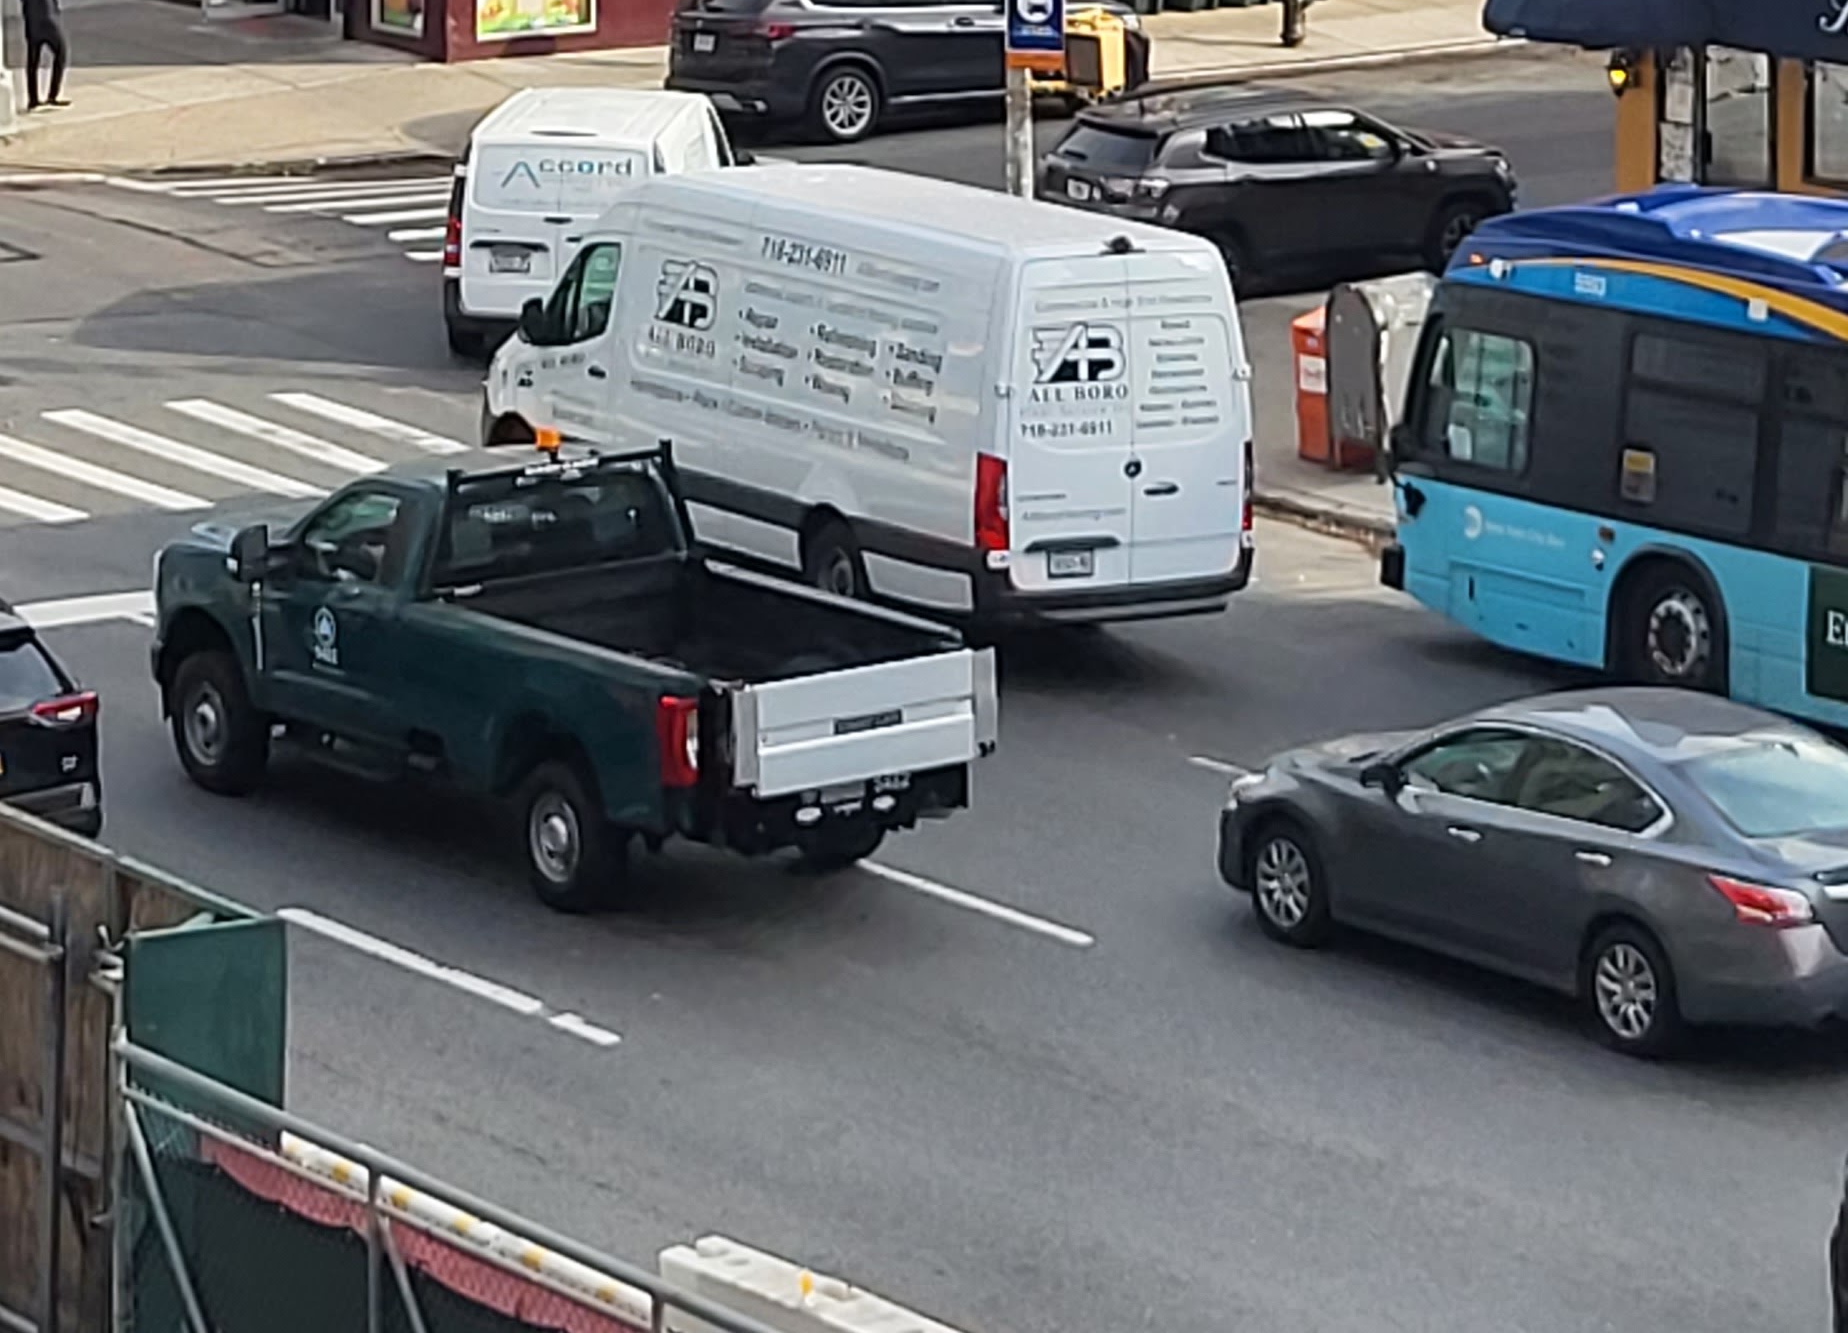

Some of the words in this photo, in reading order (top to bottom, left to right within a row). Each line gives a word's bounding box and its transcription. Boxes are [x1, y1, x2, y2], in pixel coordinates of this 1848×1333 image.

[501, 157, 631, 189] Accord
[1030, 388, 1066, 403] ALL
[1074, 383, 1128, 401] BORO
